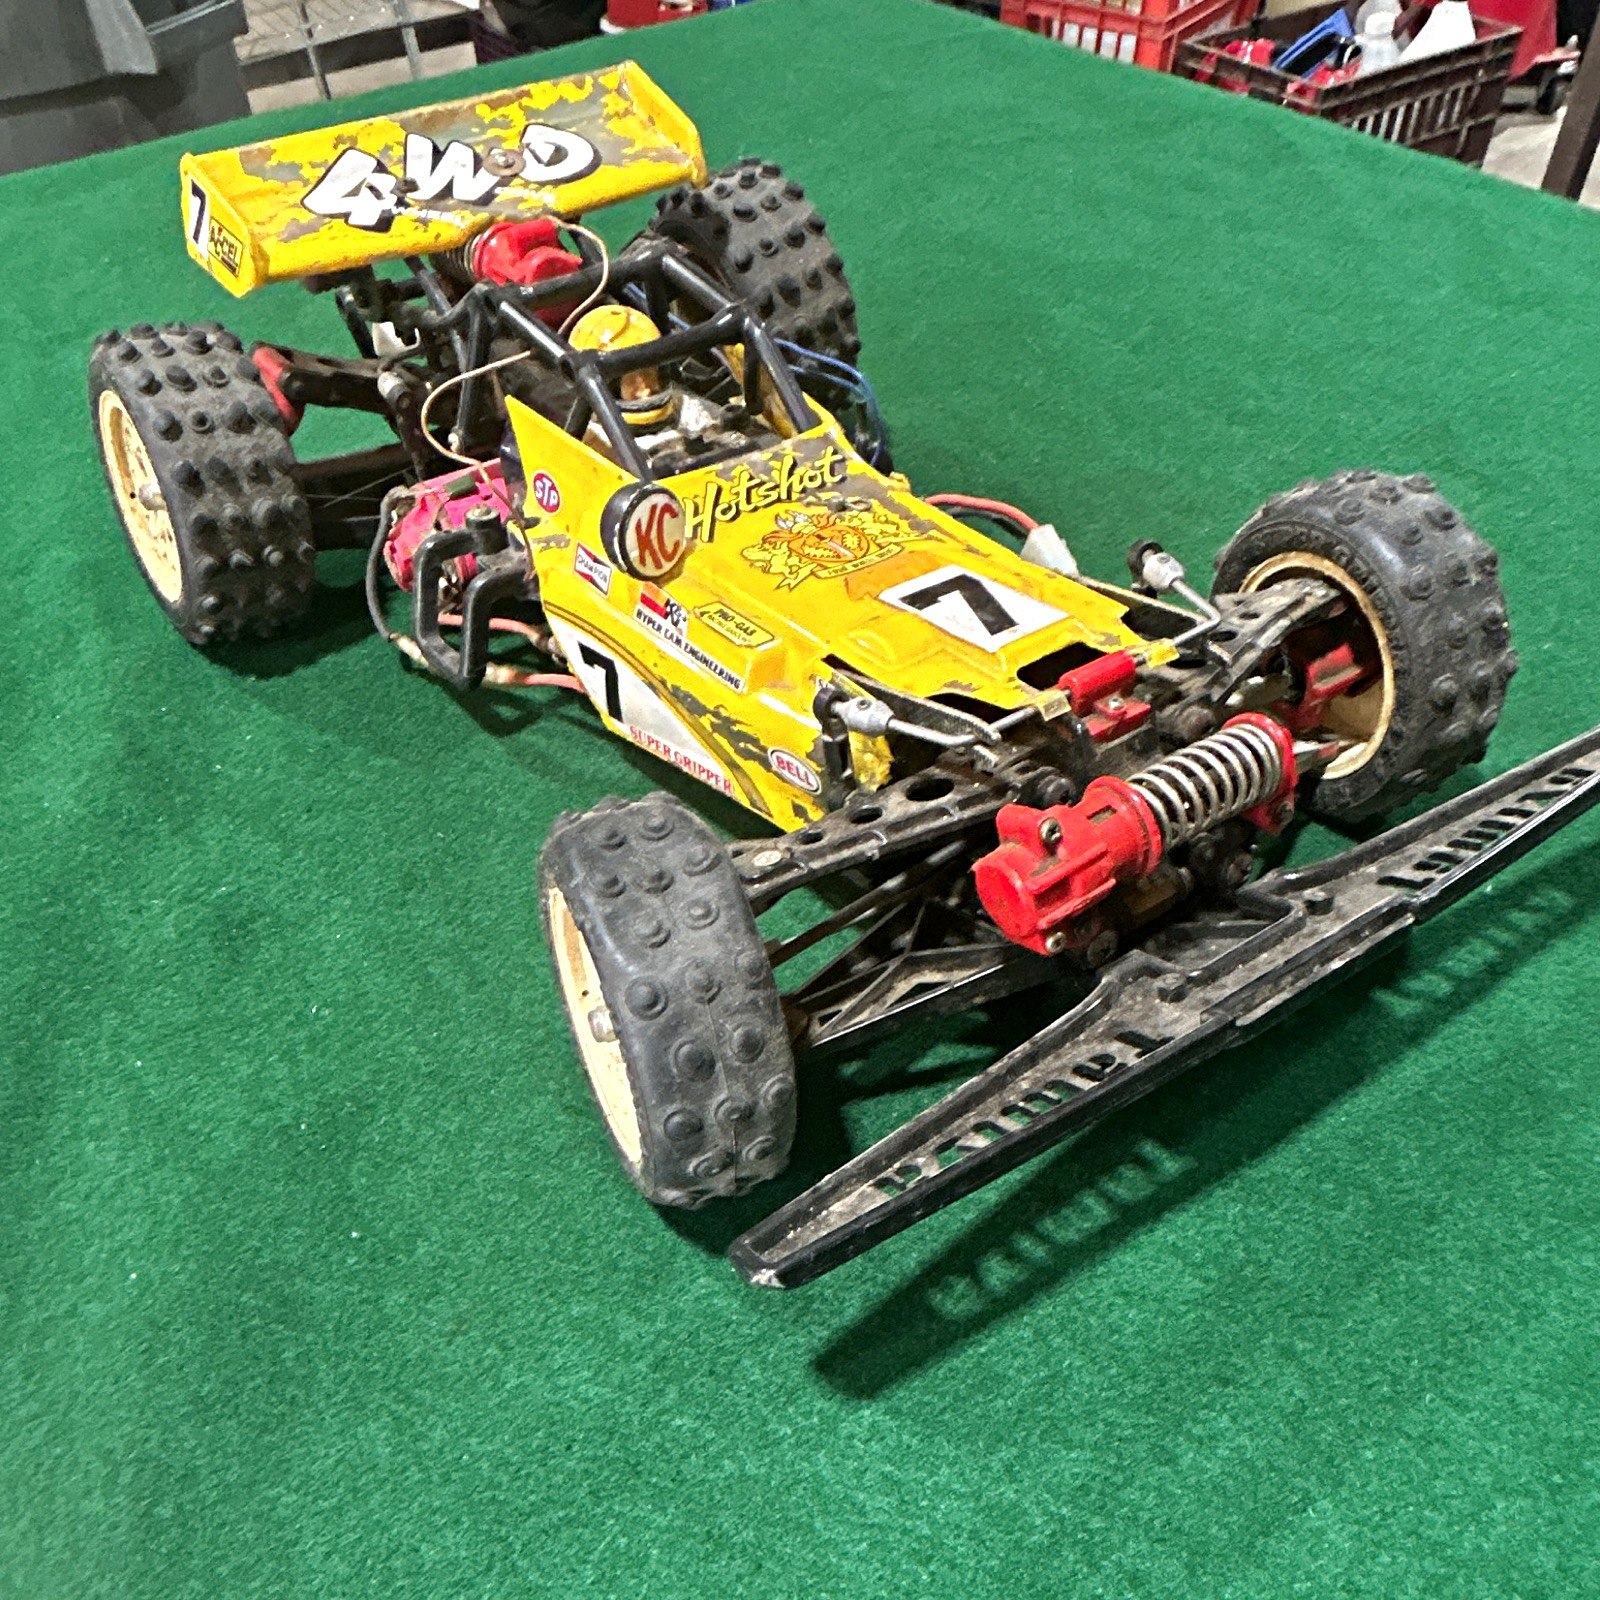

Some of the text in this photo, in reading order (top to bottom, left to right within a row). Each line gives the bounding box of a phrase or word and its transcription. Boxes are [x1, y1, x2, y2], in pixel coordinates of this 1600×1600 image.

[301, 123, 602, 233] 4WD
[191, 179, 207, 244] 7
[535, 477, 559, 506] STP
[683, 446, 848, 543] Hotshot
[577, 553, 609, 583] CHAMPION
[635, 503, 680, 569] KC
[899, 574, 1020, 636] 7
[636, 608, 662, 634] HYPER
[684, 643, 741, 689] ENGINEERING
[578, 641, 623, 723] 7
[630, 725, 733, 795] SUPER GRIPPER
[776, 755, 814, 788] BELL
